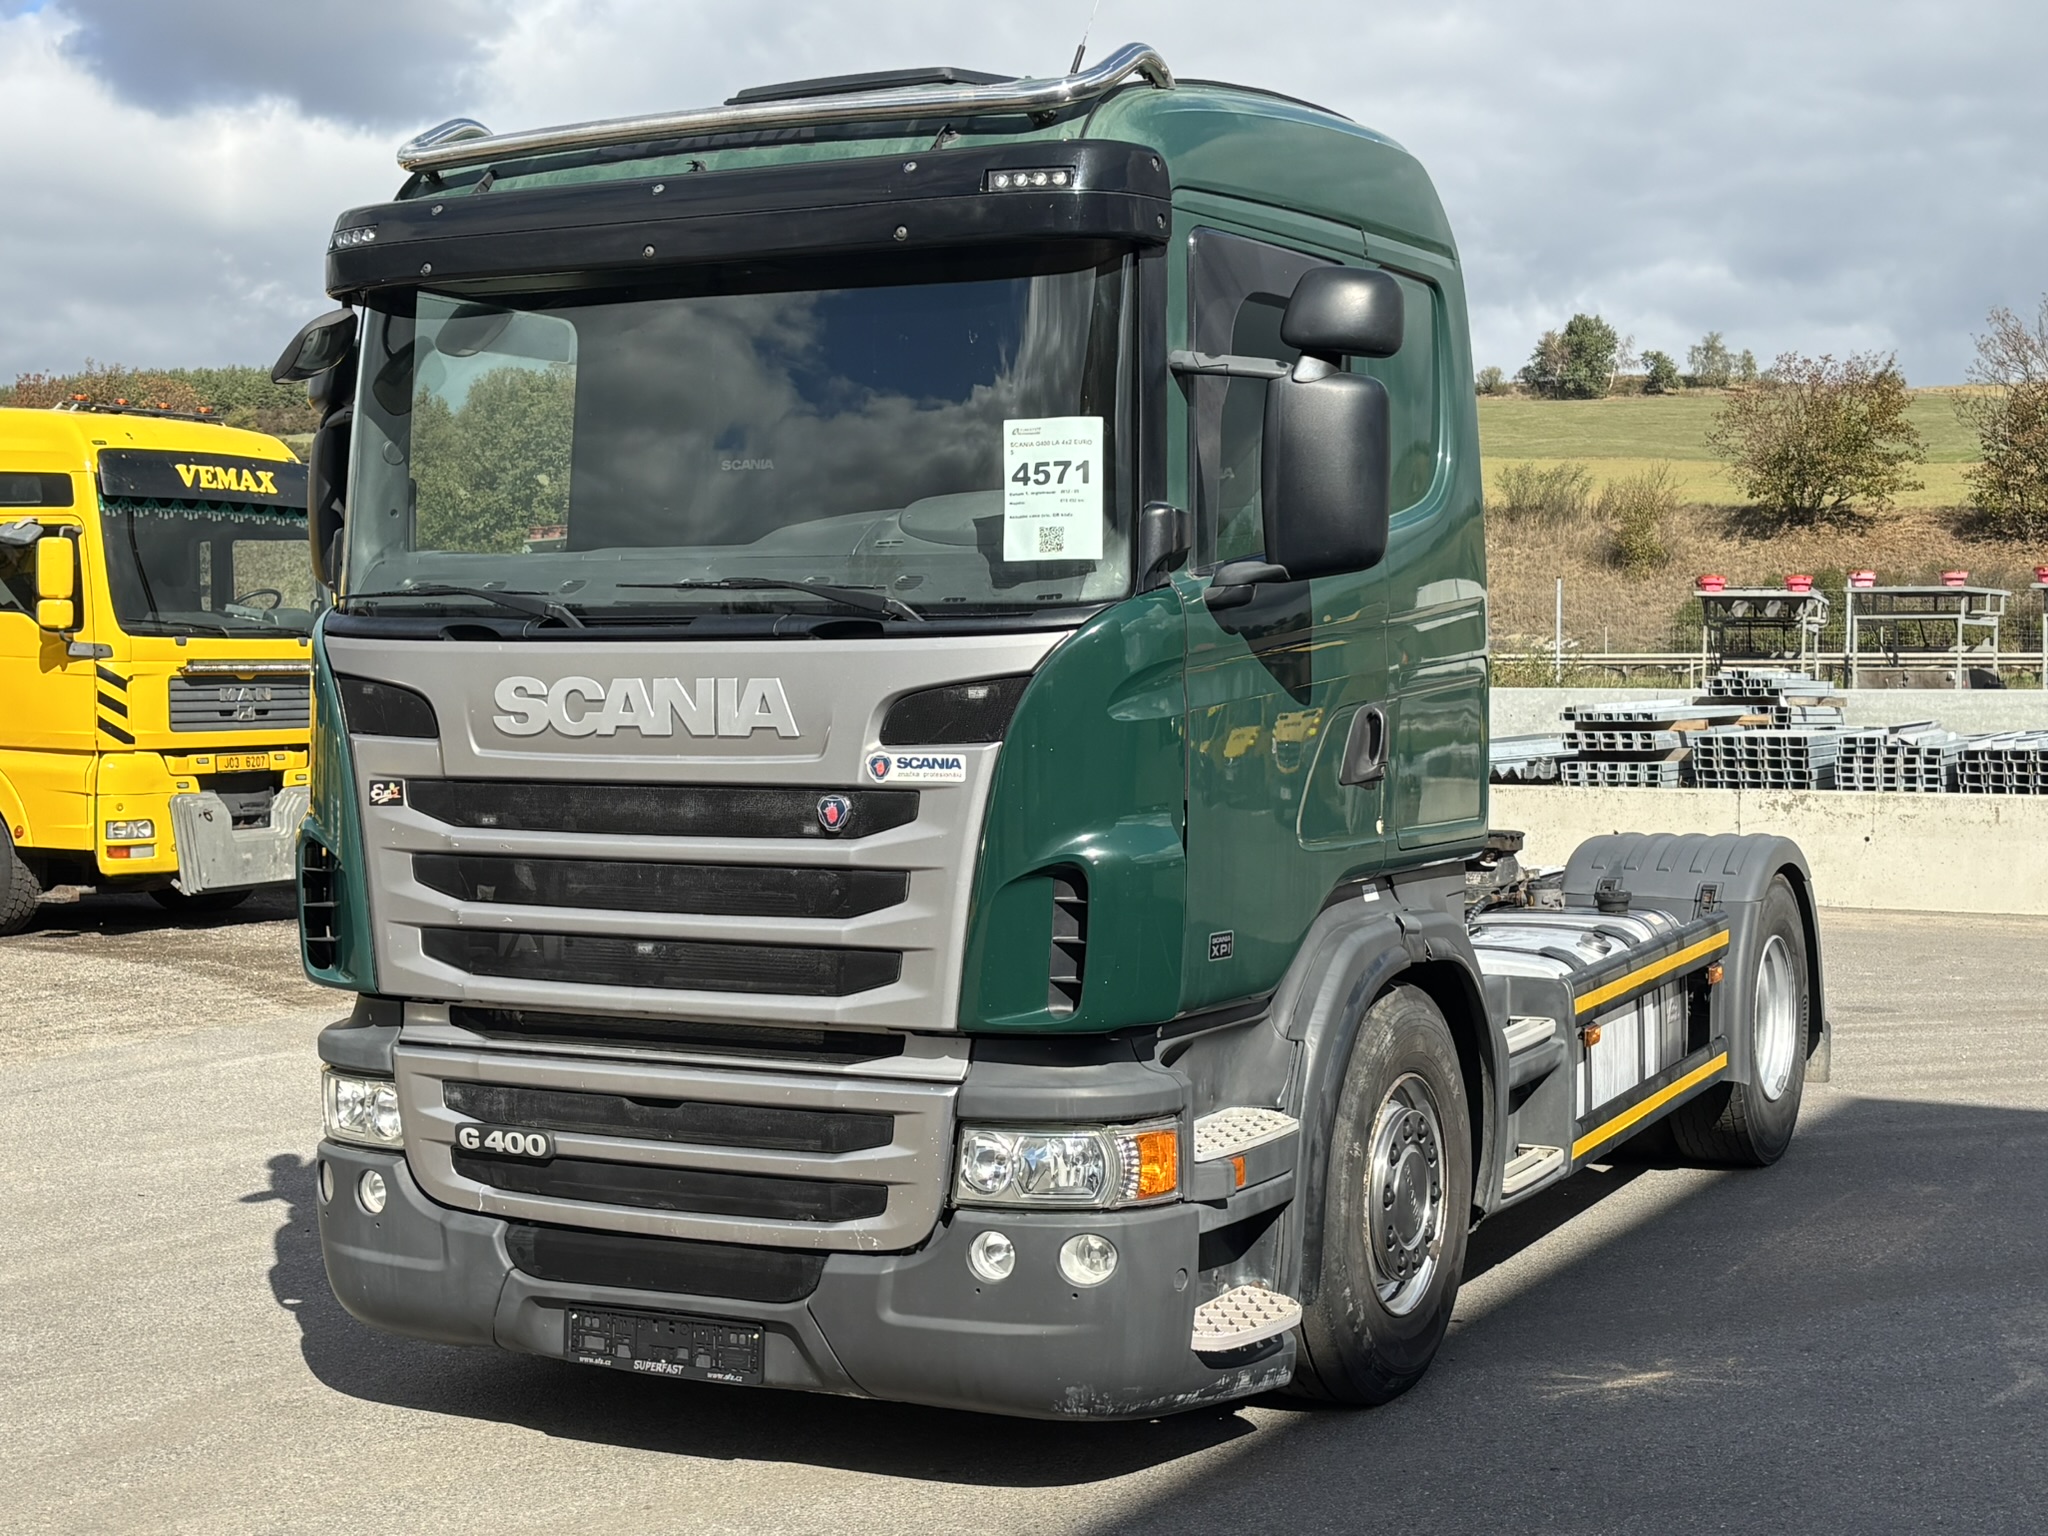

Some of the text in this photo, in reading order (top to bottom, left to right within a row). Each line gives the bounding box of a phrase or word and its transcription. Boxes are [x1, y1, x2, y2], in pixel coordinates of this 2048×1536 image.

[721, 458, 774, 471] SCANIA
[174, 463, 278, 494] VEMAX
[1011, 460, 1090, 486] 4571
[219, 687, 272, 702] MAN
[492, 675, 801, 737] SCANIA
[245, 755, 266, 768] 6207
[896, 757, 962, 770] SCANIA
[1211, 942, 1231, 957] XPI
[459, 1127, 547, 1157] G 400
[633, 1360, 684, 1375] SUPERFAST
